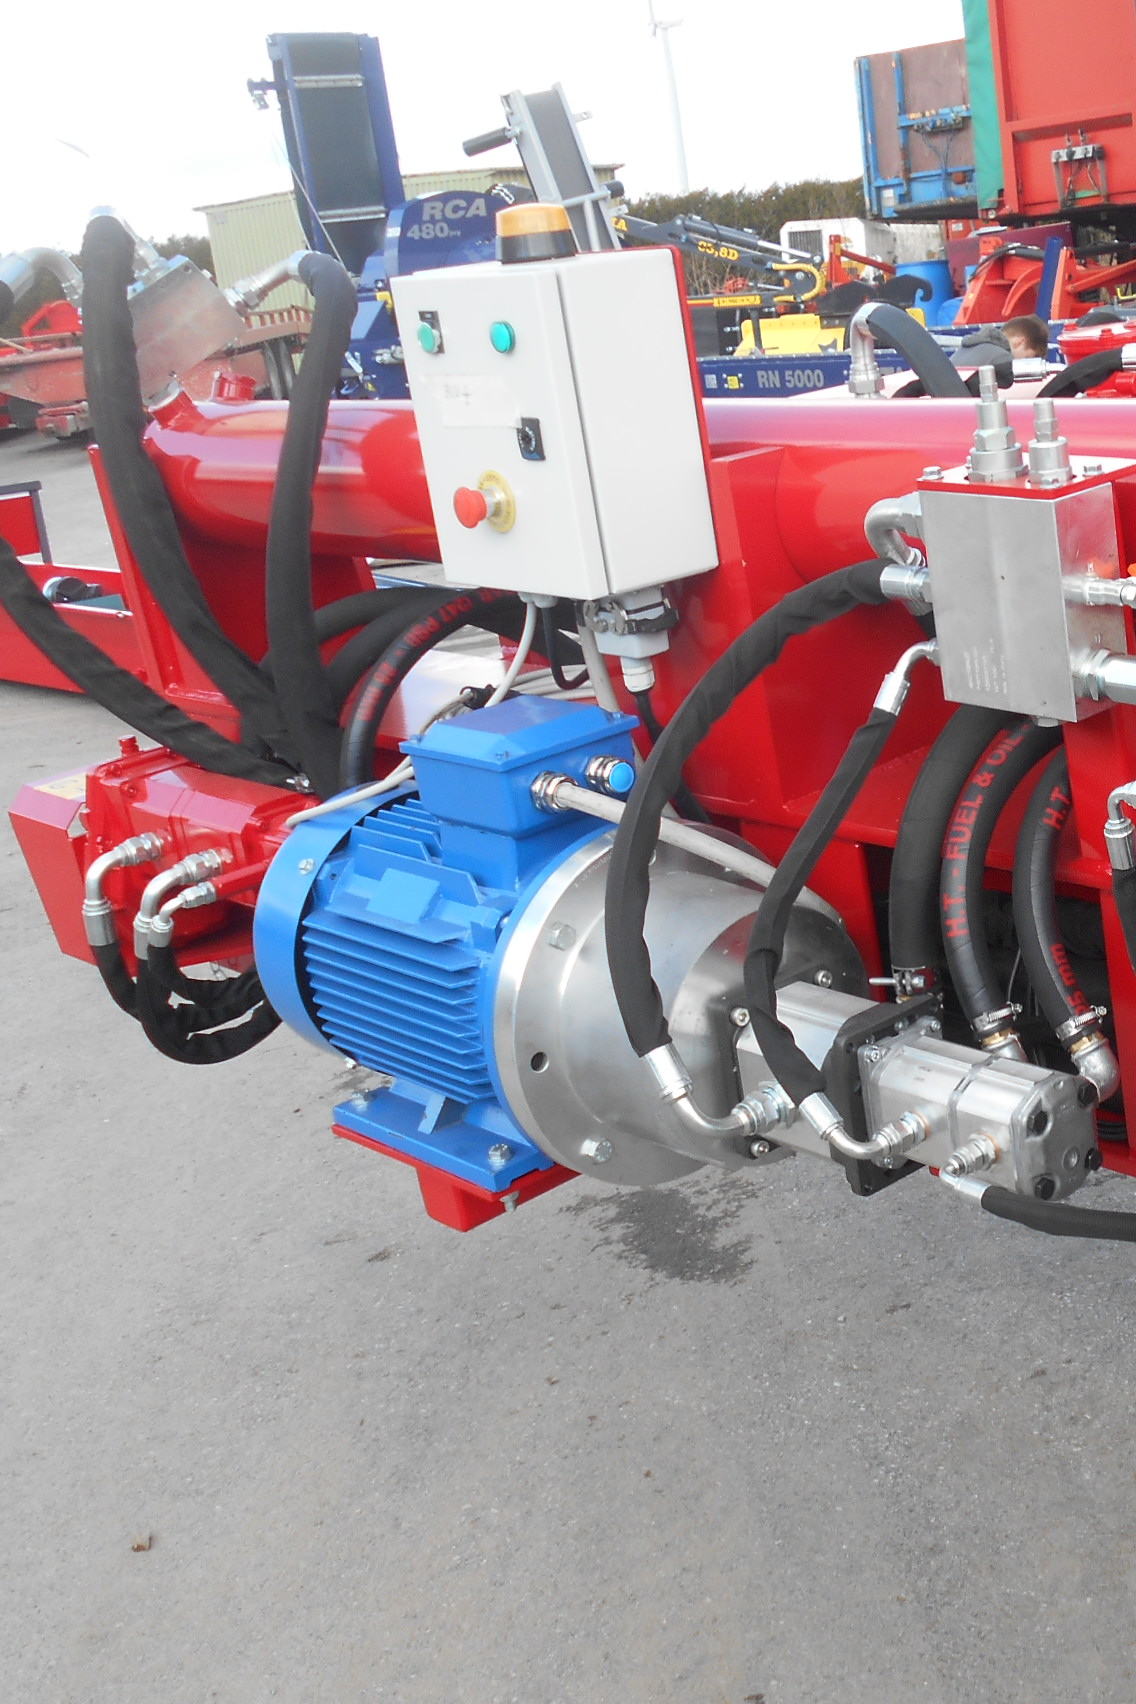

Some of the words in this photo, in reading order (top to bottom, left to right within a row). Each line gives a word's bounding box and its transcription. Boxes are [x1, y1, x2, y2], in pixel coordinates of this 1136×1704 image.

[422, 198, 487, 221] RCA
[407, 222, 449, 240] 480
[756, 370, 781, 389] RN
[785, 369, 824, 388] 5000
[948, 794, 983, 860] FUEL
[973, 773, 995, 789] &
[986, 733, 1023, 768] OIL
